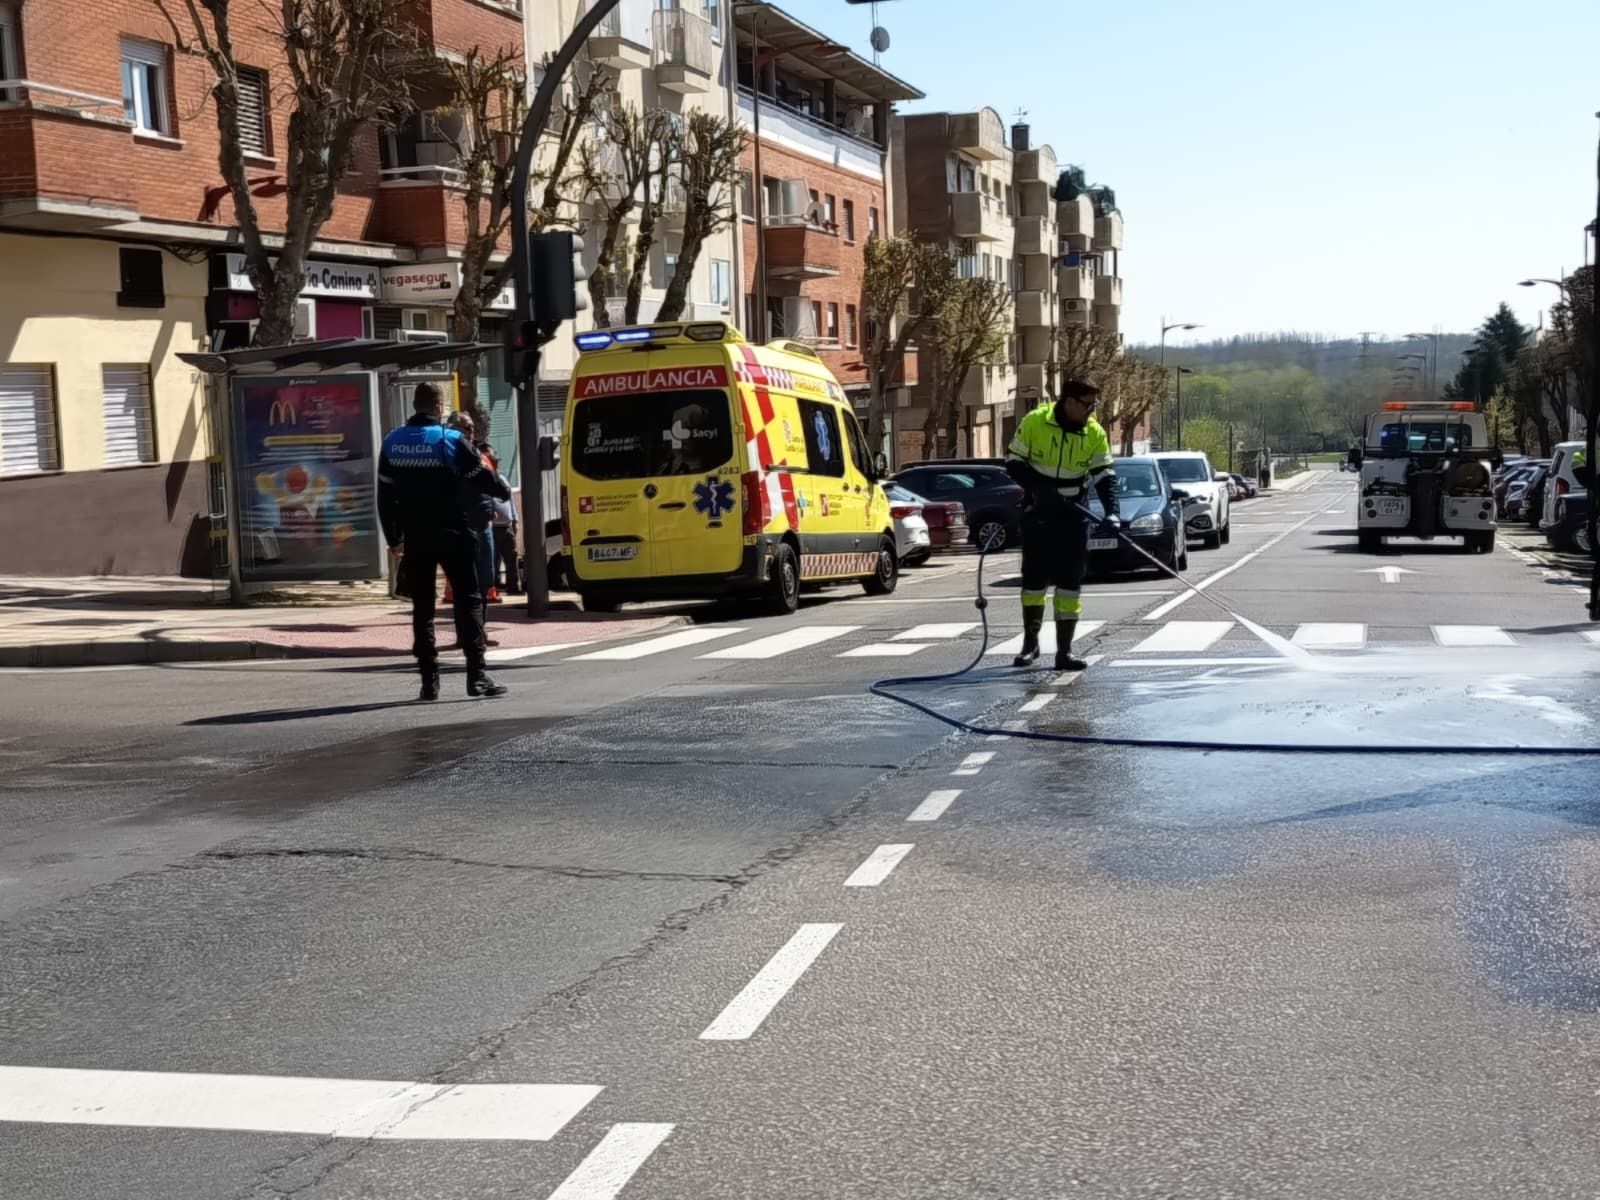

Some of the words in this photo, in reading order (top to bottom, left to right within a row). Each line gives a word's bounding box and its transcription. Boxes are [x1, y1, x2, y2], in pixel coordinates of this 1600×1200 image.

[322, 268, 362, 291] Canina
[383, 273, 448, 287] vegasegur
[584, 369, 717, 395] AMBULANCIA
[692, 428, 718, 440] Sacyl
